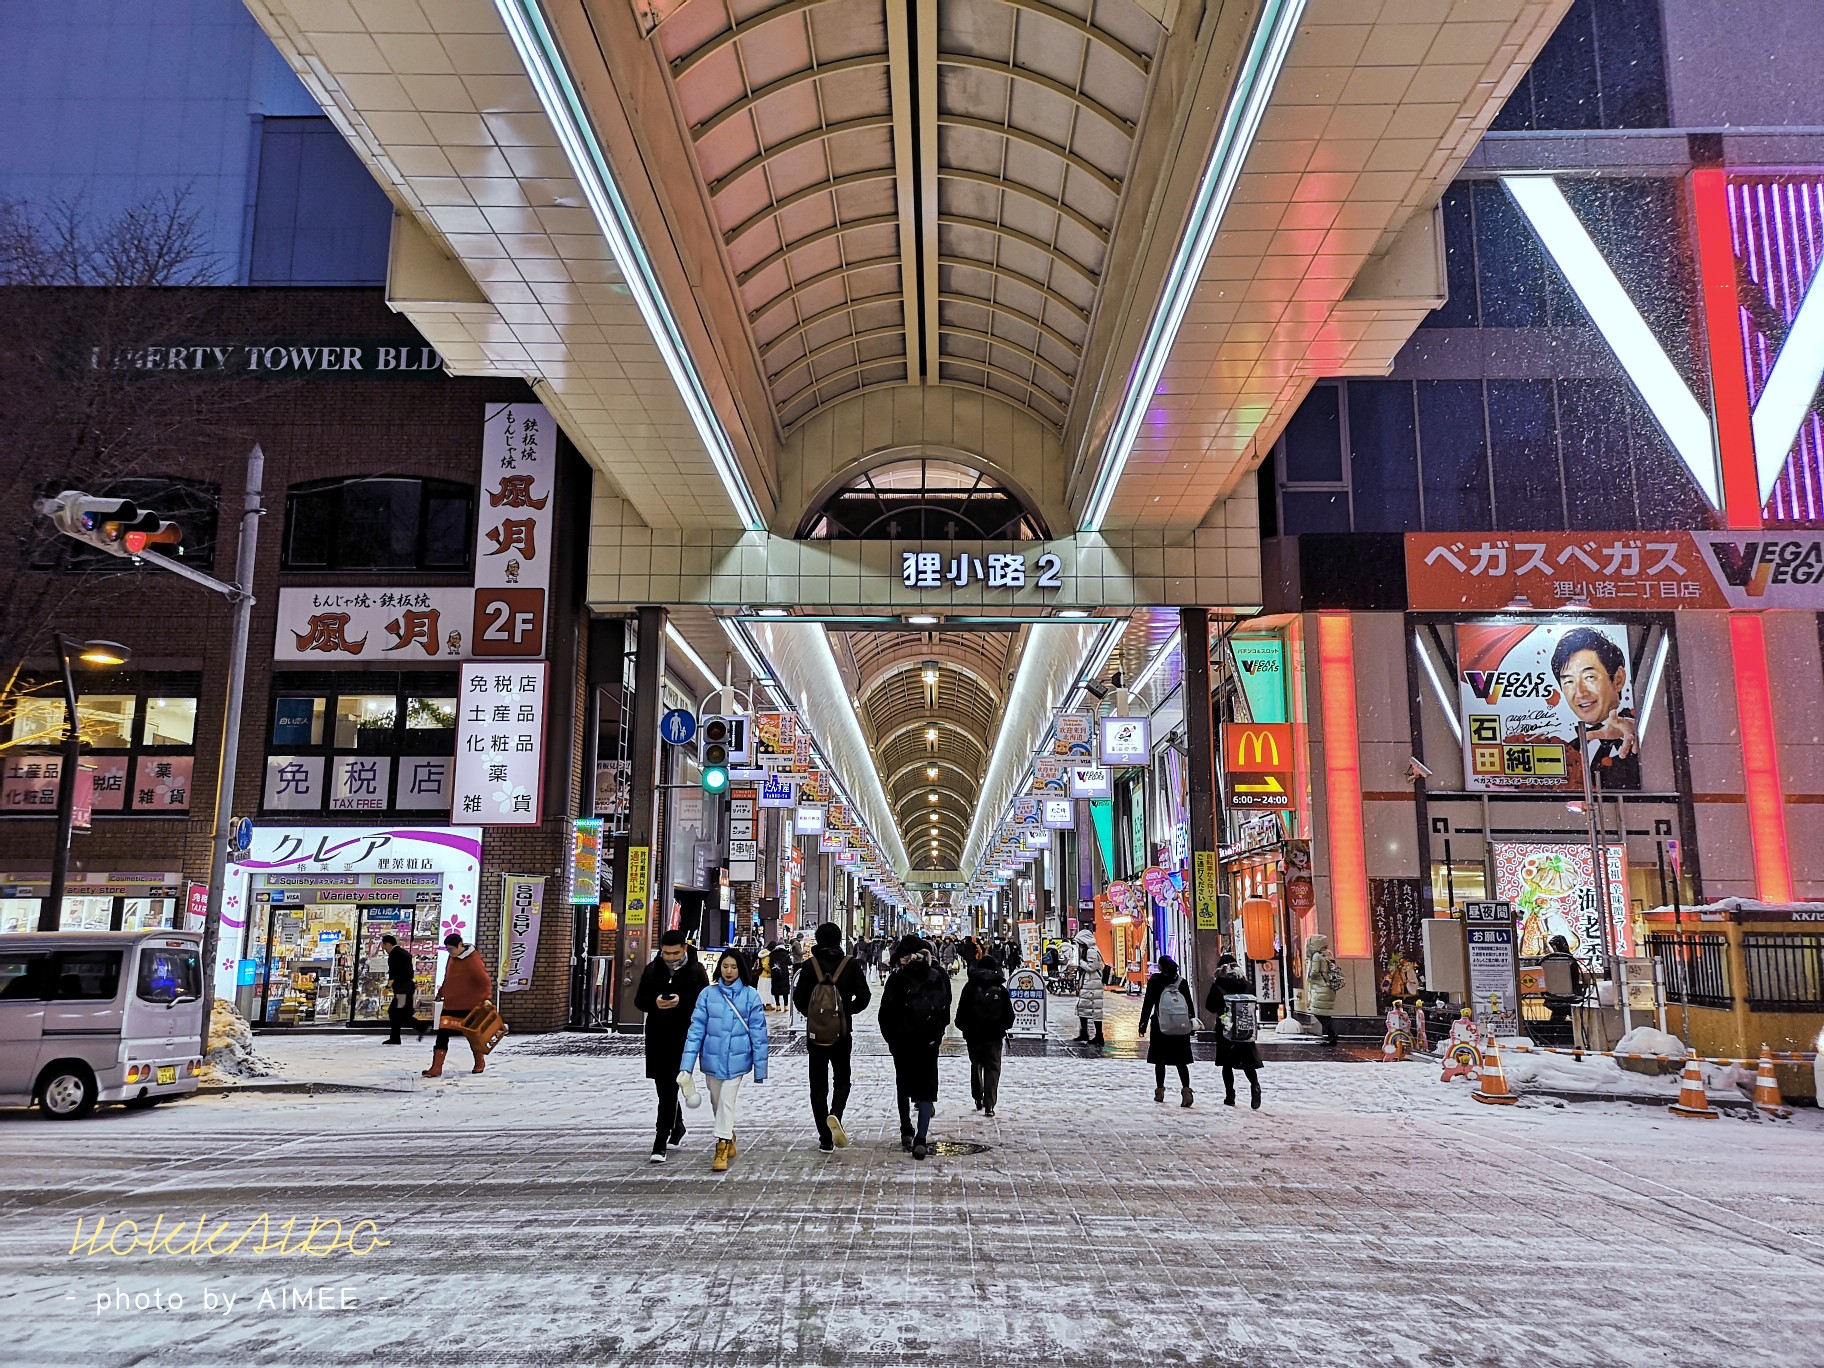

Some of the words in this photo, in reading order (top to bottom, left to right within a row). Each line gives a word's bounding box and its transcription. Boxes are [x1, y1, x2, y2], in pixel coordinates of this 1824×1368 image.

[244, 346, 363, 371] TOWER
[376, 347, 443, 370] BLD
[501, 410, 517, 469] もんじゃ焼
[521, 418, 538, 461] 鉄板焼
[1423, 540, 1688, 577] ベガスベガス
[1553, 580, 1700, 598] 狸小路二丁目店
[483, 601, 534, 644] 2F
[469, 675, 537, 693] 免税店
[1464, 672, 1546, 698] VEGAS
[467, 705, 535, 722] 土産品
[466, 735, 534, 752] 化粧品
[7, 763, 58, 779] 土産品
[156, 763, 172, 778] 薬
[275, 761, 445, 795] 免税店
[489, 765, 508, 782] 薬
[6, 789, 54, 805] 化粧品
[138, 788, 185, 804] 雑貨
[333, 799, 353, 809] TAX
[356, 799, 383, 809] FREE
[463, 795, 531, 813] 雑貨
[272, 834, 391, 864] クレア
[629, 851, 639, 894] 通行禁止
[1609, 860, 1620, 880] 元祖
[110, 875, 145, 883] Cosmetic
[279, 876, 315, 886] Squishy
[376, 877, 417, 885] Cosmetic
[65, 886, 96, 894] ariety
[100, 886, 126, 894] store
[322, 891, 365, 904] Variety
[368, 891, 400, 901] store
[512, 884, 533, 937] SQUISHY
[1468, 905, 1508, 920] 昼夜間
[1472, 931, 1507, 942] お願い
[1011, 990, 1043, 999] 歩行者専用
